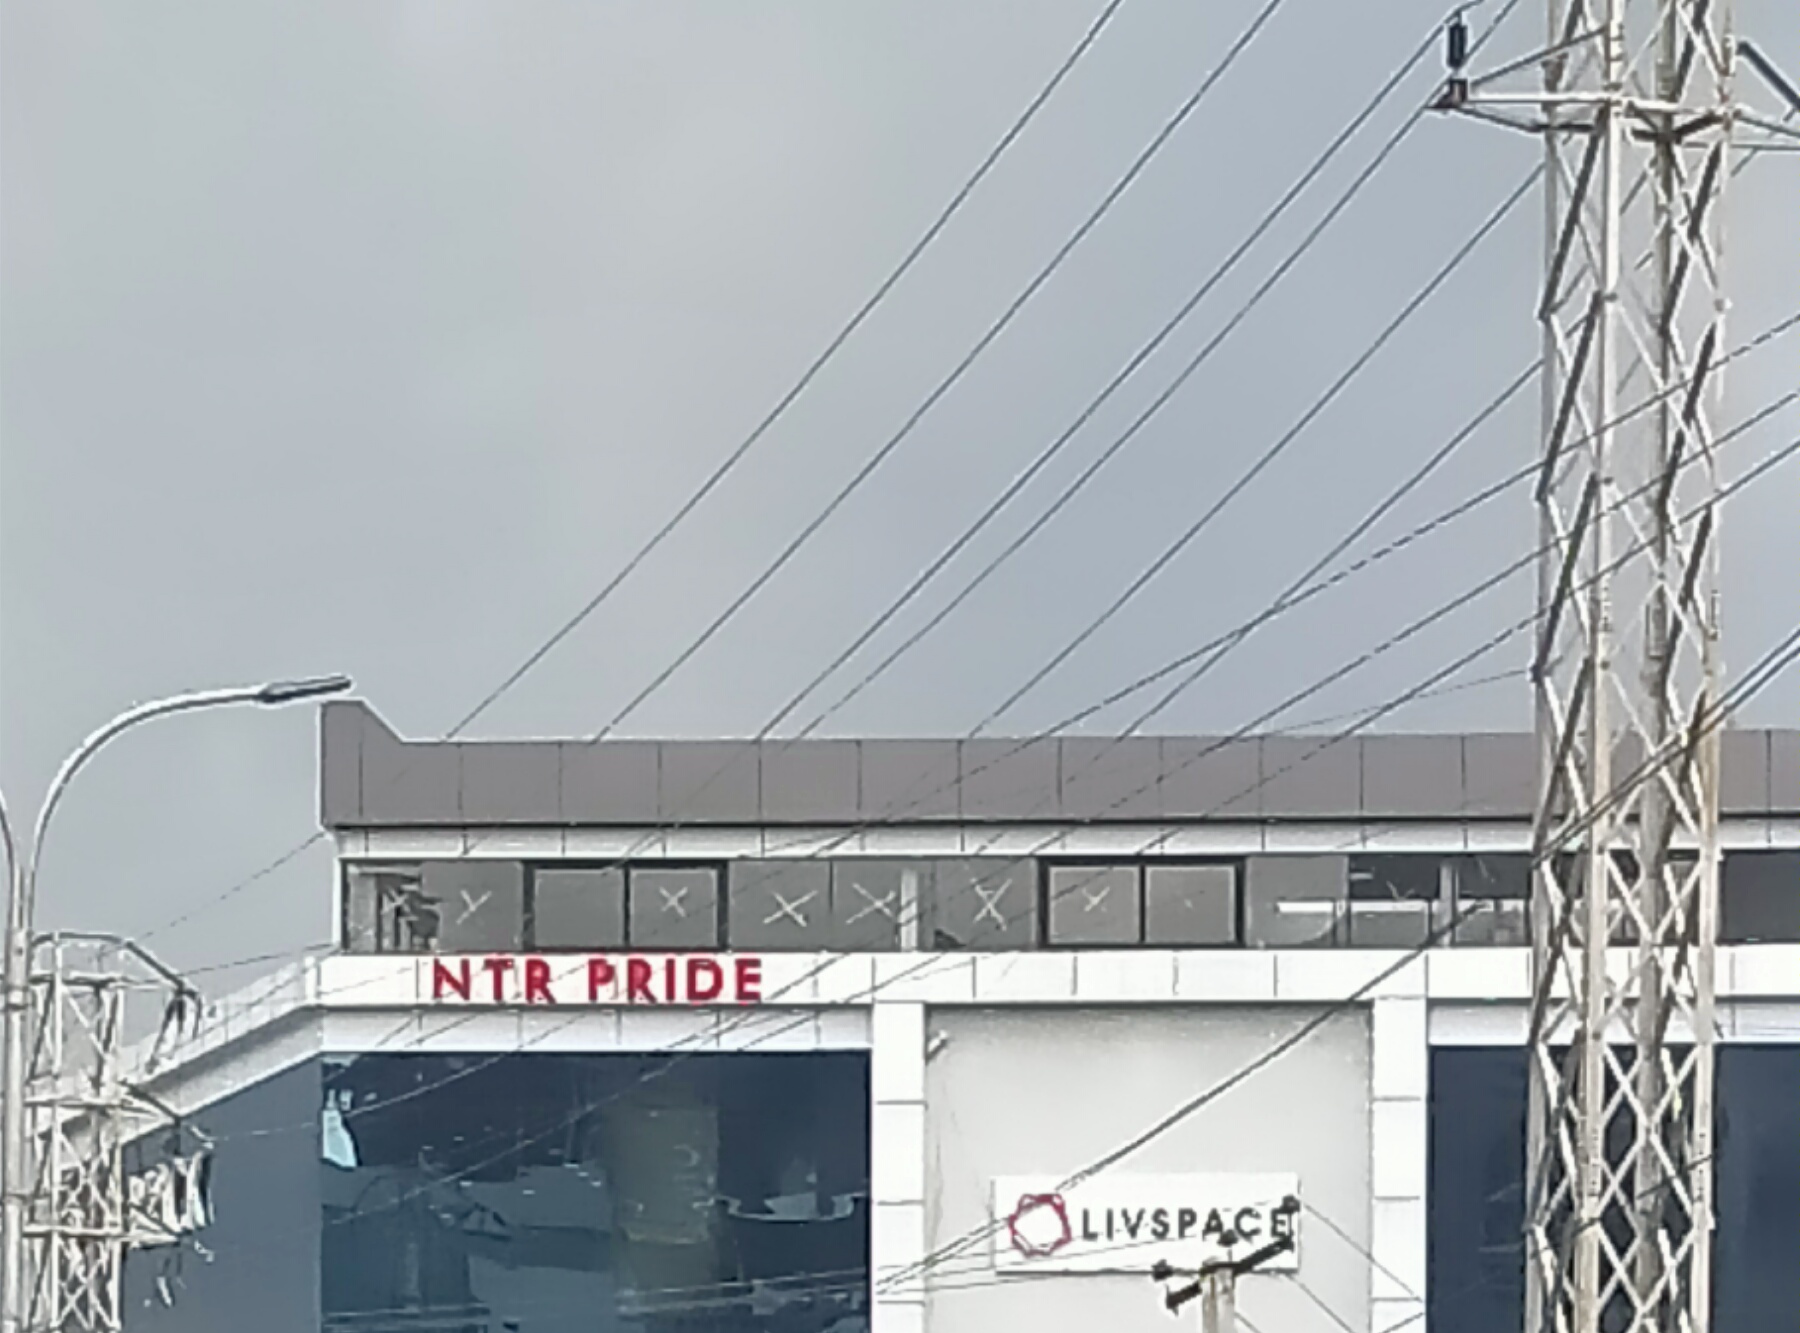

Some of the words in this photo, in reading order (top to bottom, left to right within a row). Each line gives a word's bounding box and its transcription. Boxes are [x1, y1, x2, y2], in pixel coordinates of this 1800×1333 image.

[433, 957, 555, 1002] NTR
[587, 957, 762, 1002] PRIDE
[1082, 1207, 1292, 1240] LIVSPACE
